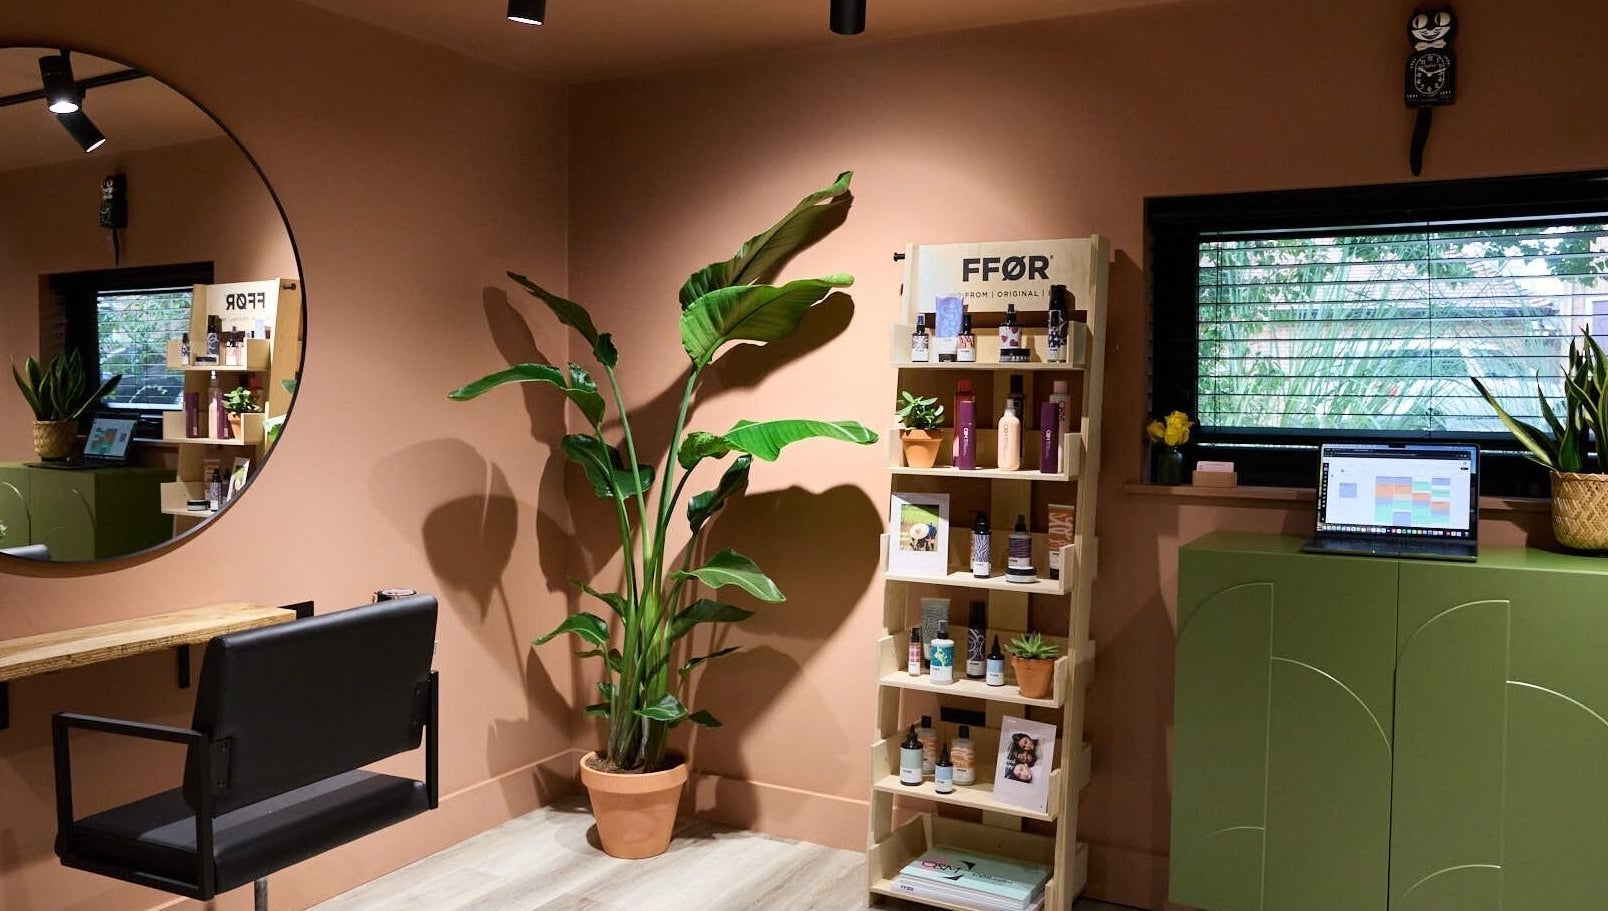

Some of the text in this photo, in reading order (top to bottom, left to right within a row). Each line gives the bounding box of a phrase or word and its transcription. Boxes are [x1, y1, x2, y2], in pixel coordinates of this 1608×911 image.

[962, 255, 1049, 282] FFØR
[965, 291, 988, 299] FROM
[997, 289, 1039, 298] ORIGINAL
